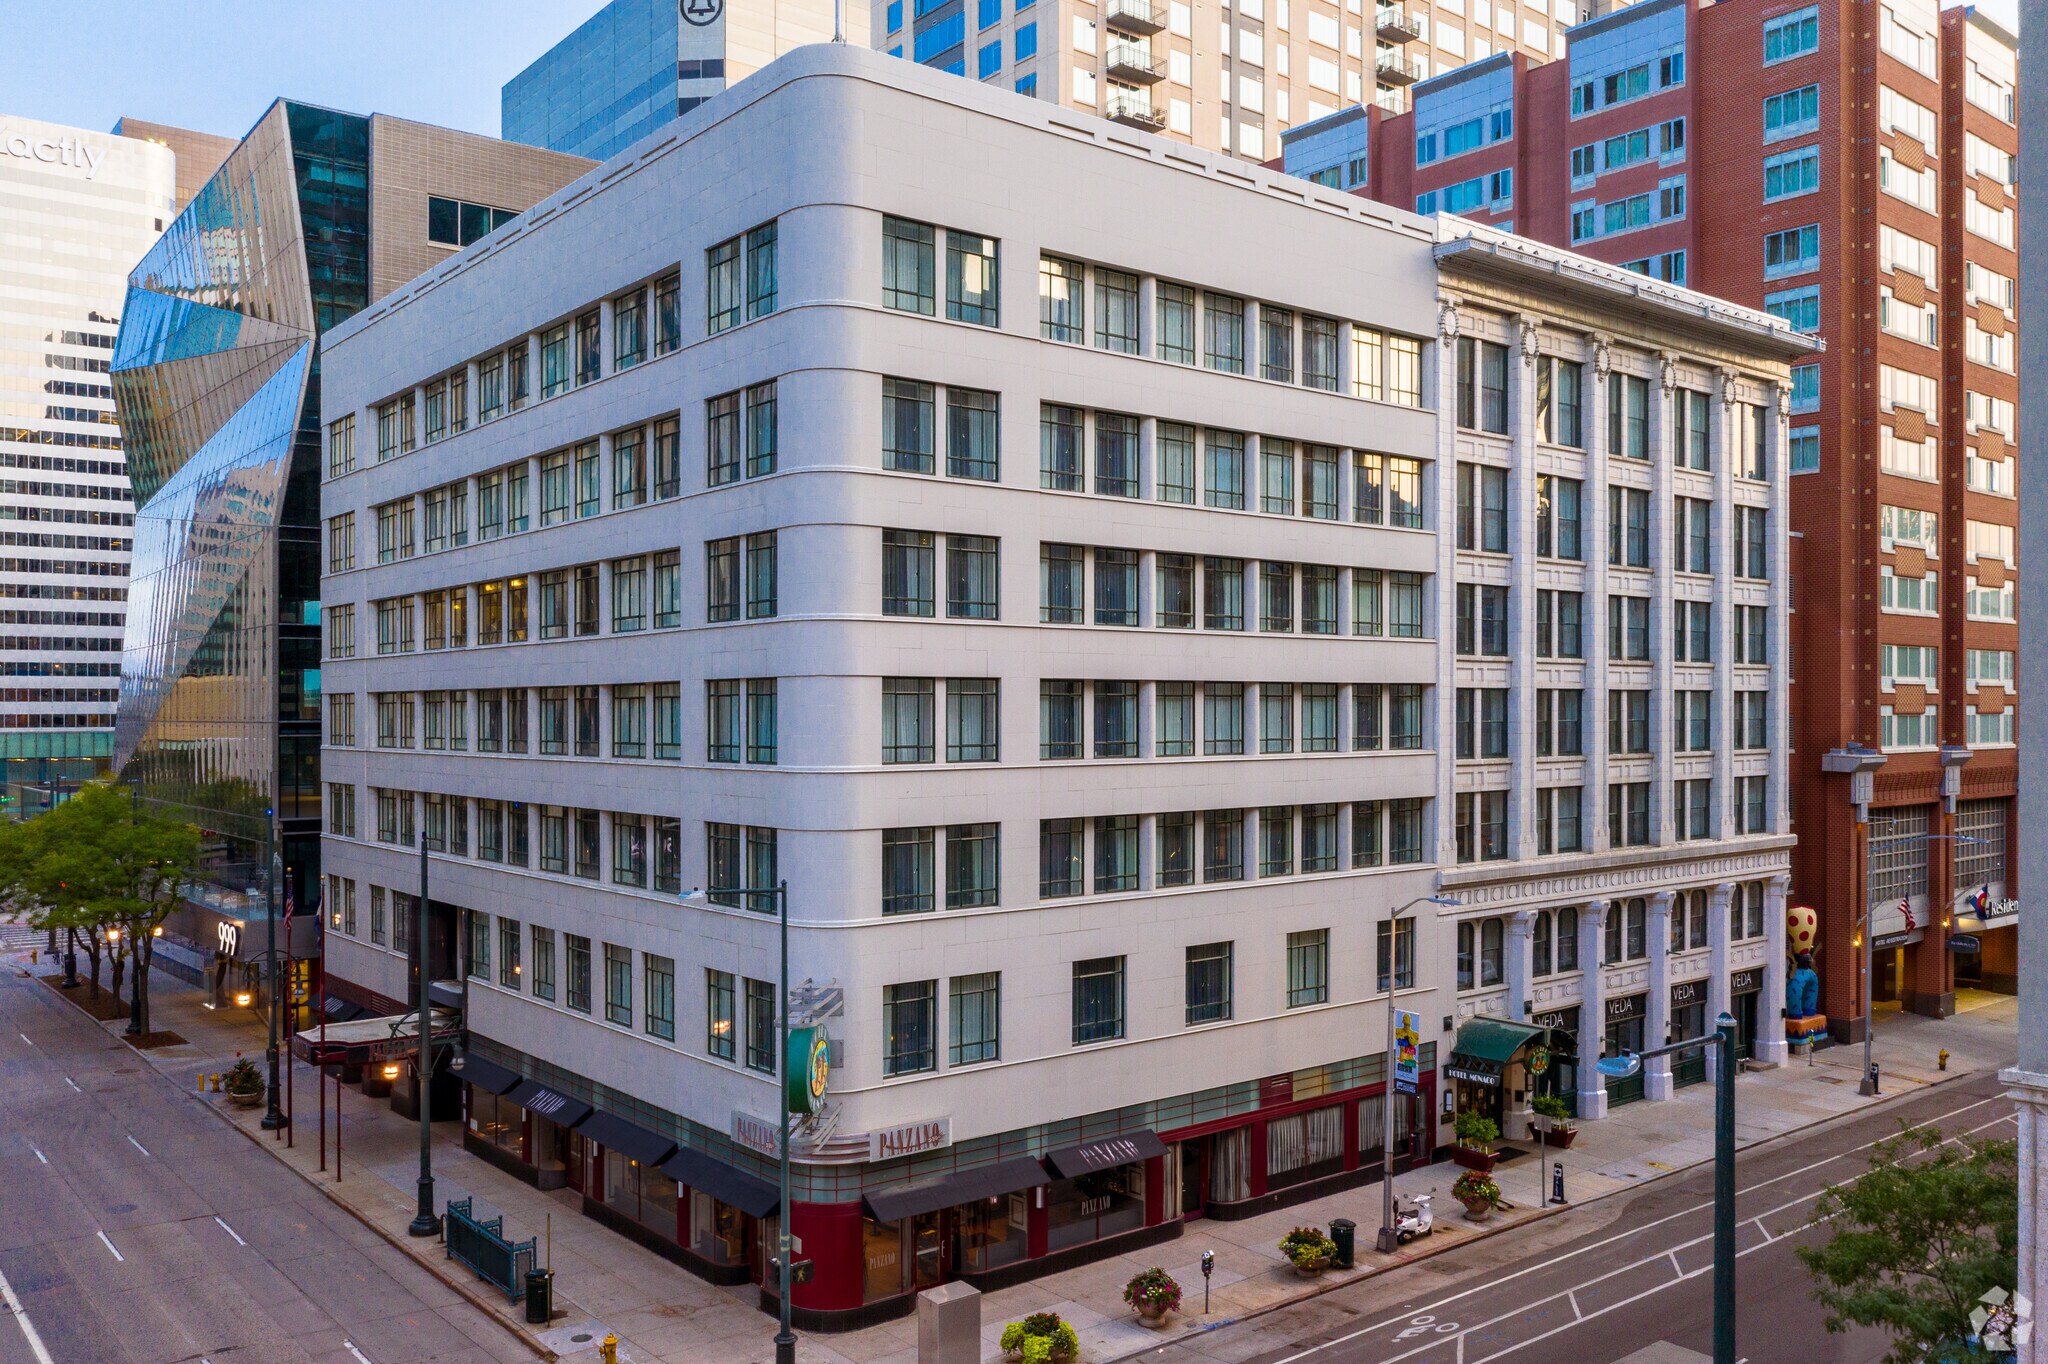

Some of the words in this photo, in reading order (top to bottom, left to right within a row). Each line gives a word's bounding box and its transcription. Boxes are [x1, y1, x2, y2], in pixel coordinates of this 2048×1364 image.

[218, 921, 237, 956] 999
[1732, 972, 1752, 988] VEDA
[1673, 984, 1695, 1000] VEDA
[1608, 998, 1632, 1015] VEDA
[1538, 1012, 1564, 1028] VEDA
[1448, 1069, 1467, 1079] HOTEL
[1469, 1073, 1495, 1085] MONACO
[737, 1117, 775, 1155] PANZANO
[879, 1122, 942, 1158] PANZANO
[1081, 1195, 1111, 1216] PANZANO
